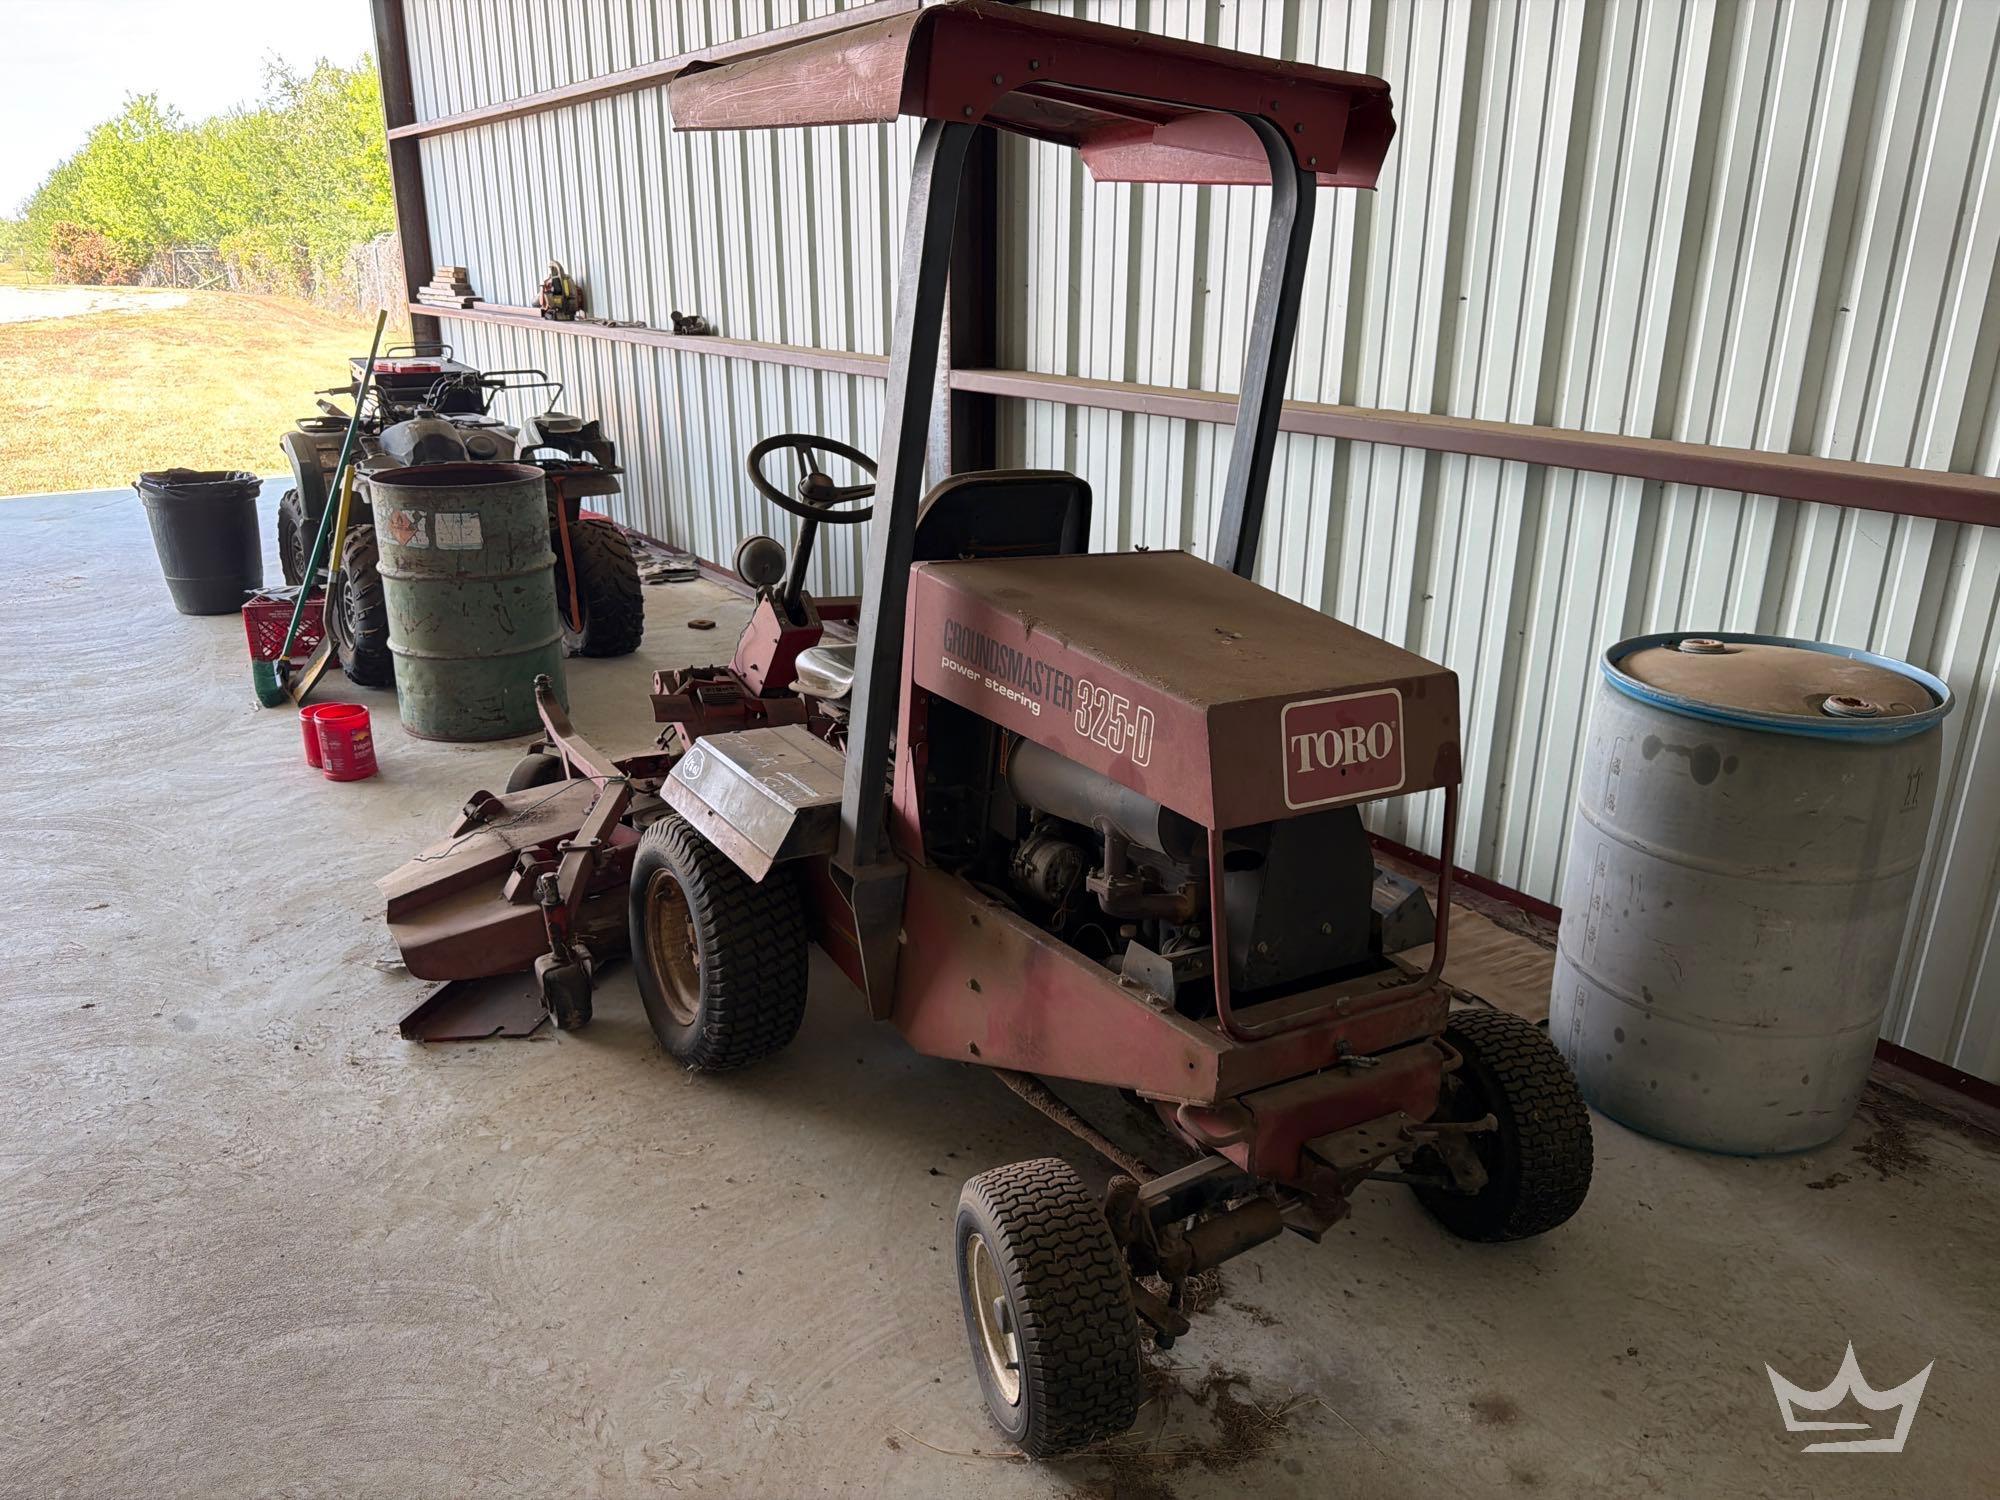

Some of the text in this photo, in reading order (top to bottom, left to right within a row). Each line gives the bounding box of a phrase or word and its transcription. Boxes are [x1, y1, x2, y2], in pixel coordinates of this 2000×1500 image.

[941, 655, 1041, 717] power steering
[943, 618, 1075, 713] GROUNDSMASTER
[1291, 721, 1394, 773] TORO
